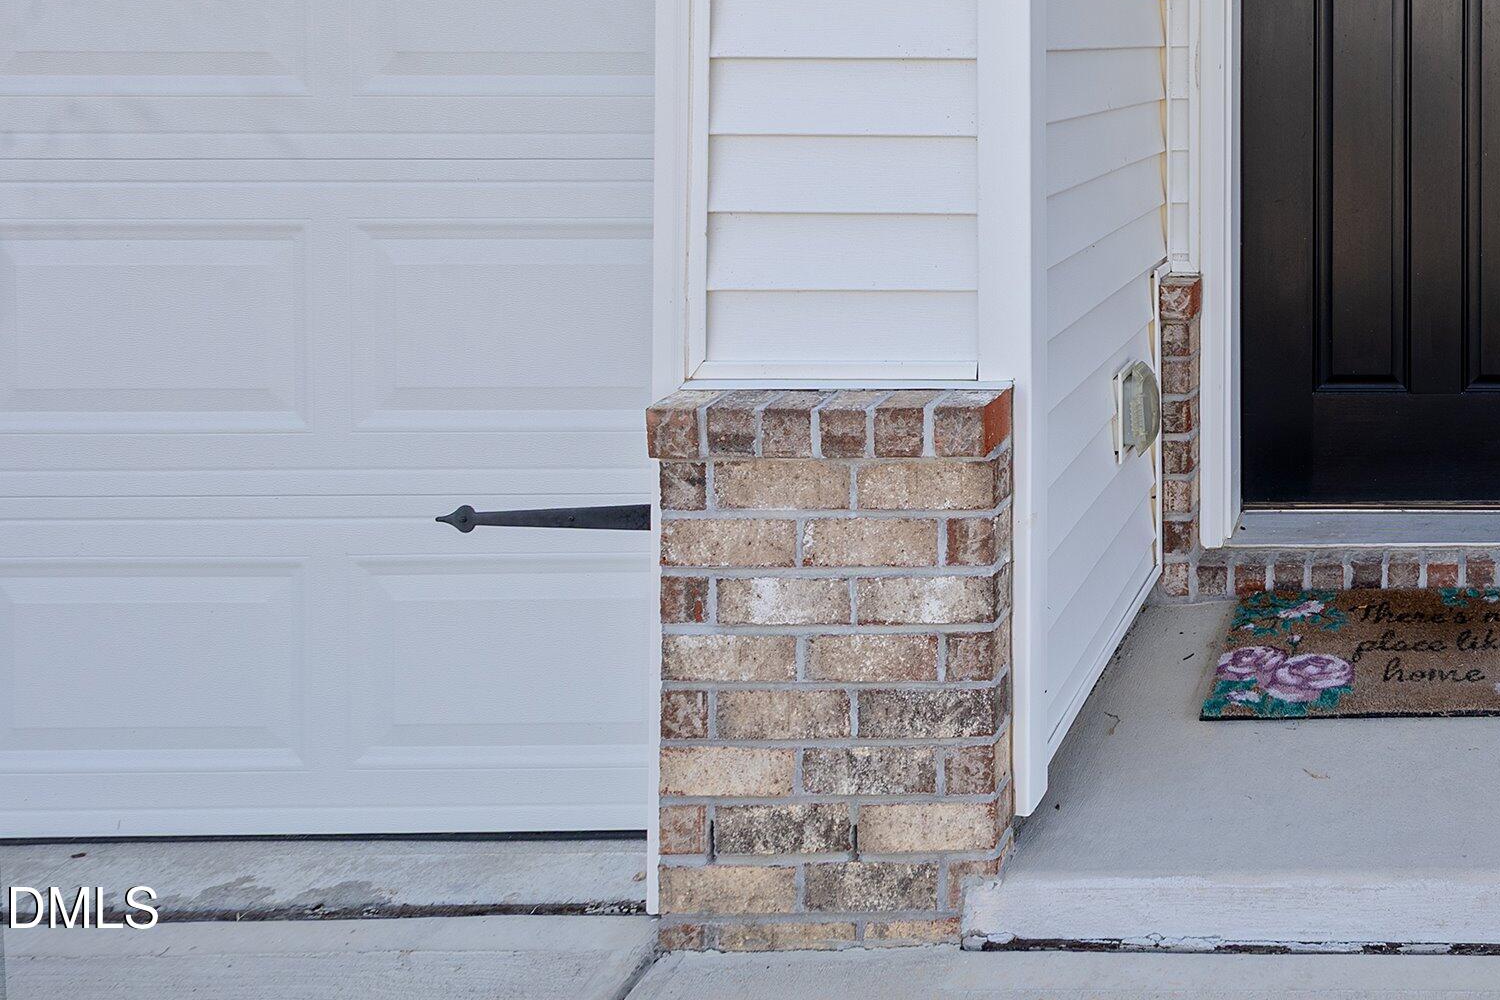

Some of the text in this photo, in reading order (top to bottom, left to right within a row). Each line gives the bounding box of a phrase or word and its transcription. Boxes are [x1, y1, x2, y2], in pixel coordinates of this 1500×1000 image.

[1348, 601, 1471, 625] There's
[1352, 628, 1447, 664] place
[1382, 656, 1486, 683] home
